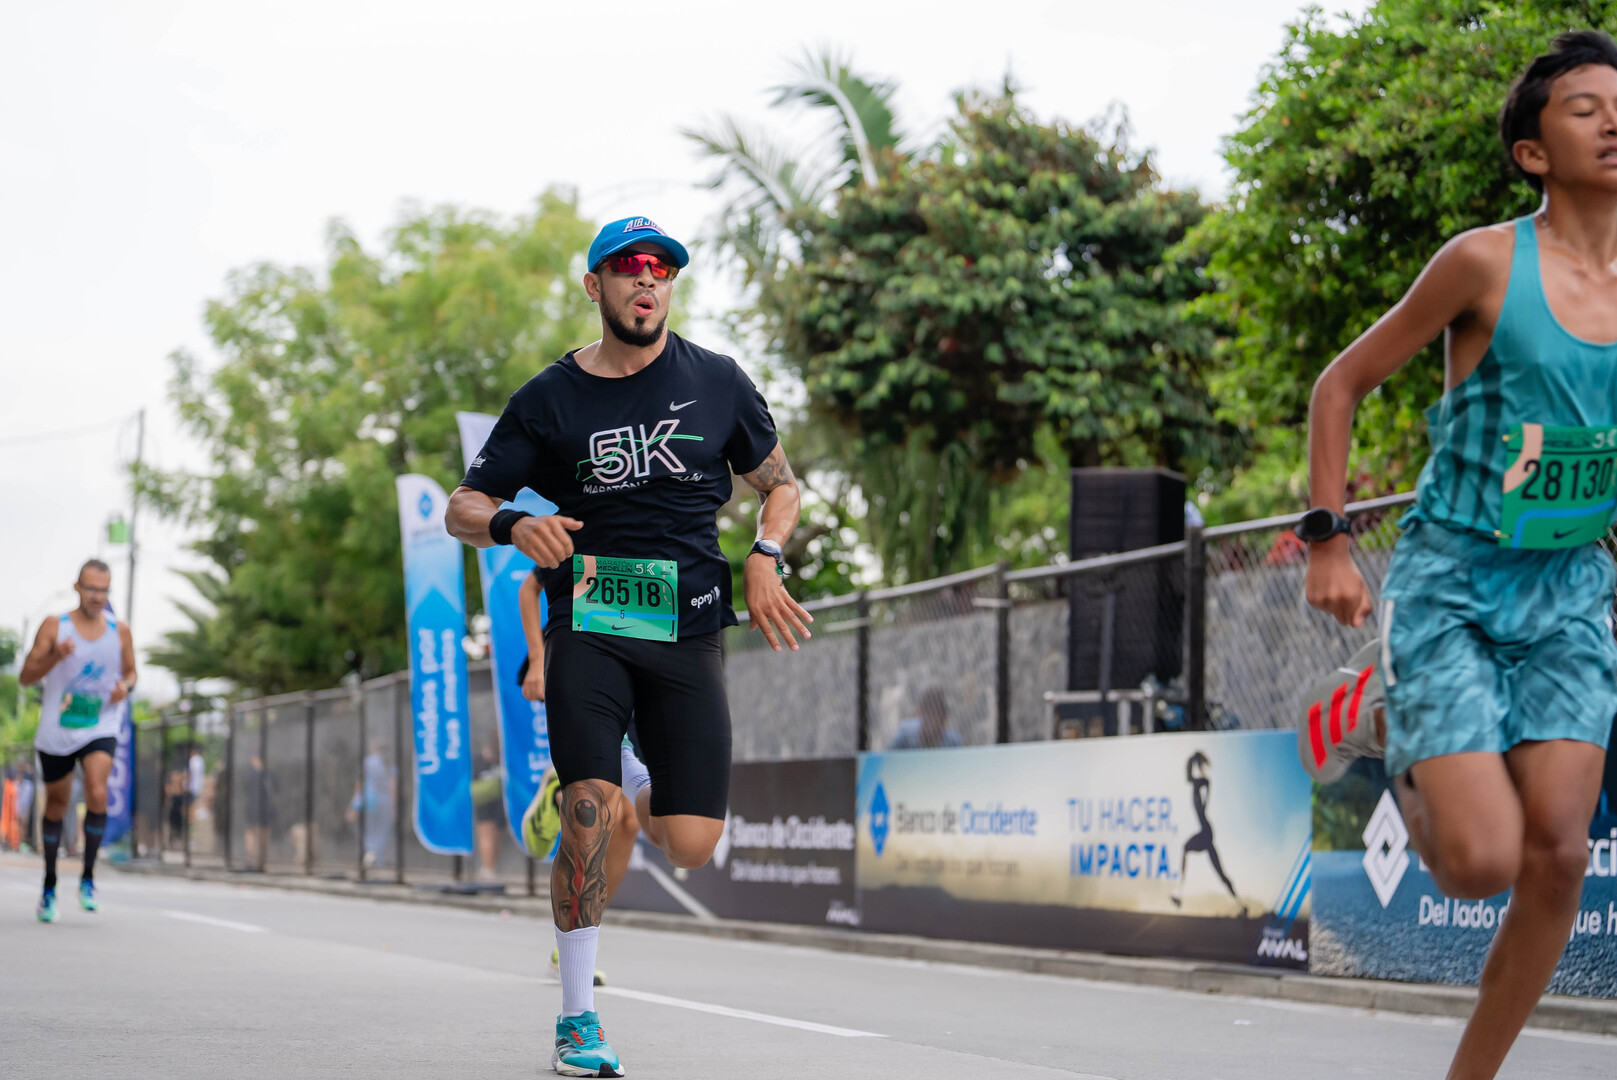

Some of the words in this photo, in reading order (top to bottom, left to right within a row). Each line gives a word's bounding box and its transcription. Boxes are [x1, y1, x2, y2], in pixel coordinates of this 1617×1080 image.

[589, 419, 687, 483] 5K
[1521, 457, 1613, 501] 28130
[634, 562, 656, 576] 5K
[585, 577, 661, 607] 26518
[690, 593, 713, 609] epm
[620, 609, 625, 619] 5
[417, 679, 440, 774] Unidos
[895, 803, 936, 835] Banco
[941, 803, 957, 836] de
[958, 802, 1038, 836] Occidente
[1065, 797, 1093, 832] TU
[1098, 797, 1178, 835] HACER,
[1069, 843, 1179, 878] IMPACTA.
[1418, 895, 1449, 926] Del
[1452, 897, 1495, 929] lado
[1257, 938, 1308, 961] AVAL
